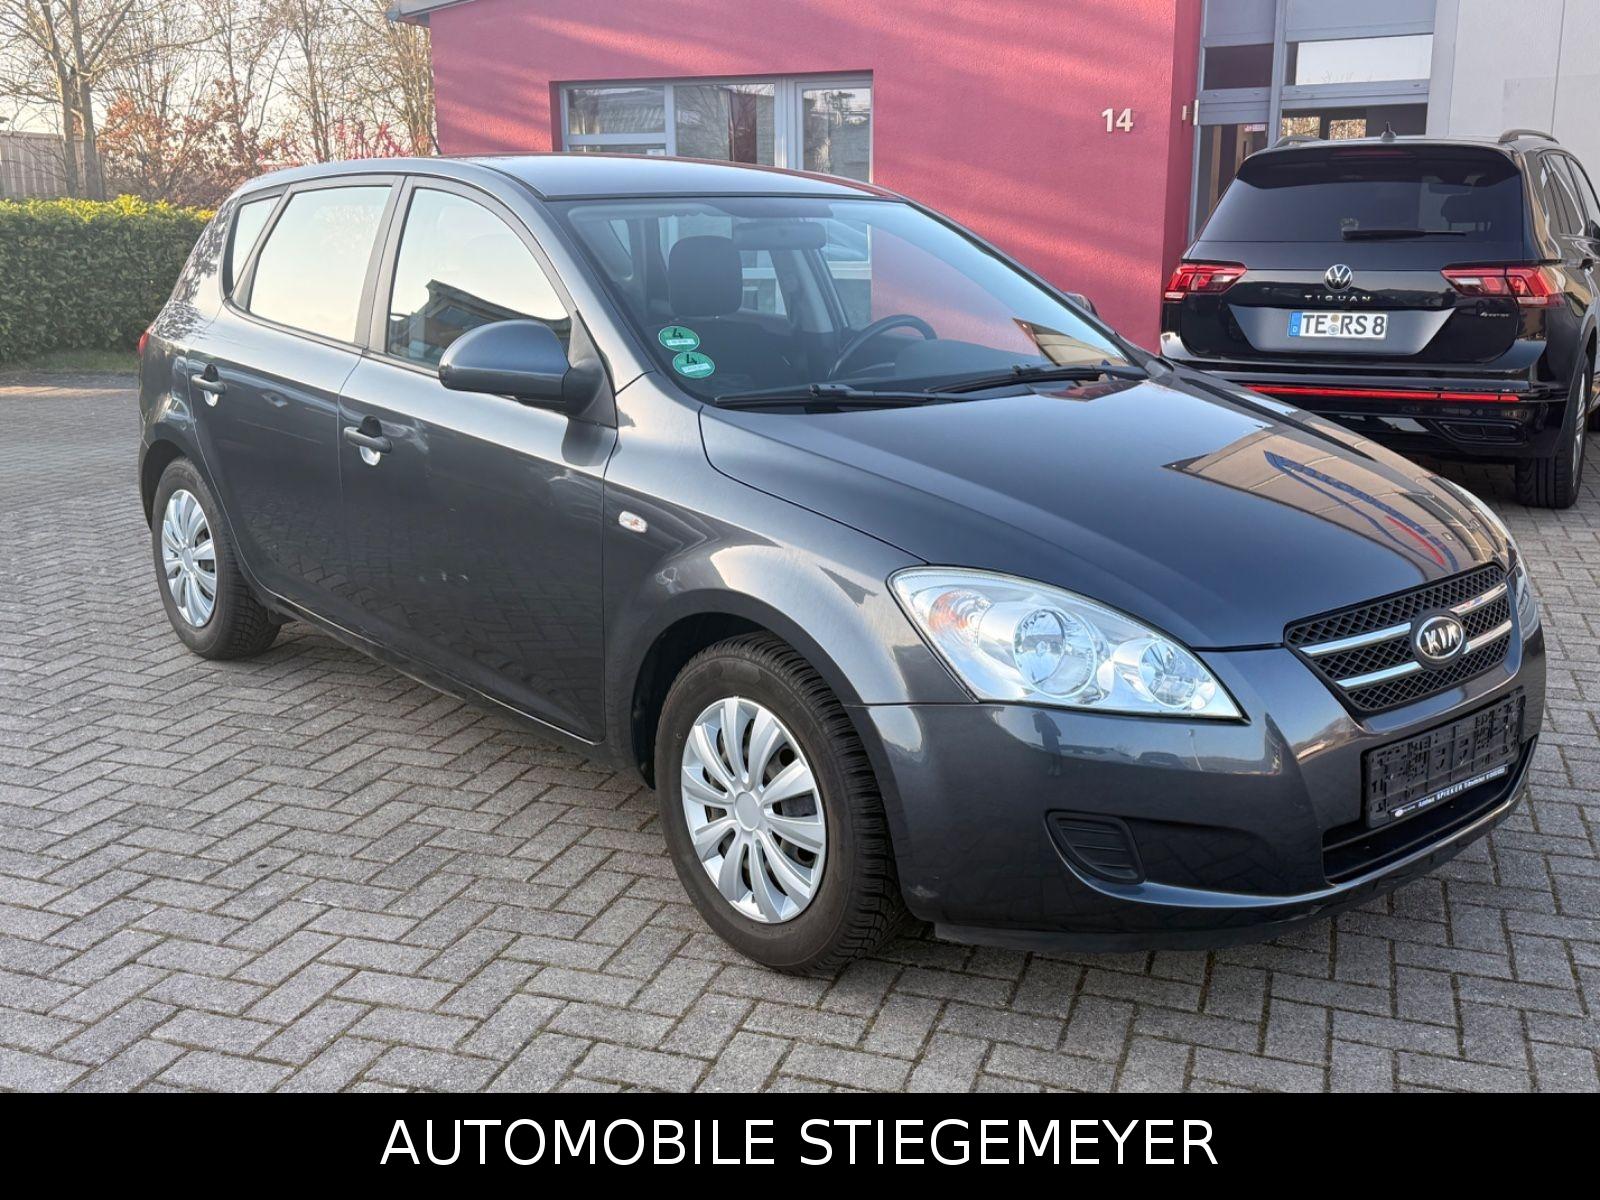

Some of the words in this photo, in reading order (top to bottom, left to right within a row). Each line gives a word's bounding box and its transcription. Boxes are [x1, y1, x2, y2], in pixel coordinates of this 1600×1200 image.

[1101, 108, 1134, 133] 14
[1304, 294, 1372, 302] TIGUAN
[1303, 314, 1328, 334] TE
[1340, 315, 1367, 335] RS
[1372, 316, 1385, 335] 8
[672, 328, 683, 338] 4
[686, 354, 698, 364] 4
[1424, 624, 1459, 654] KIA
